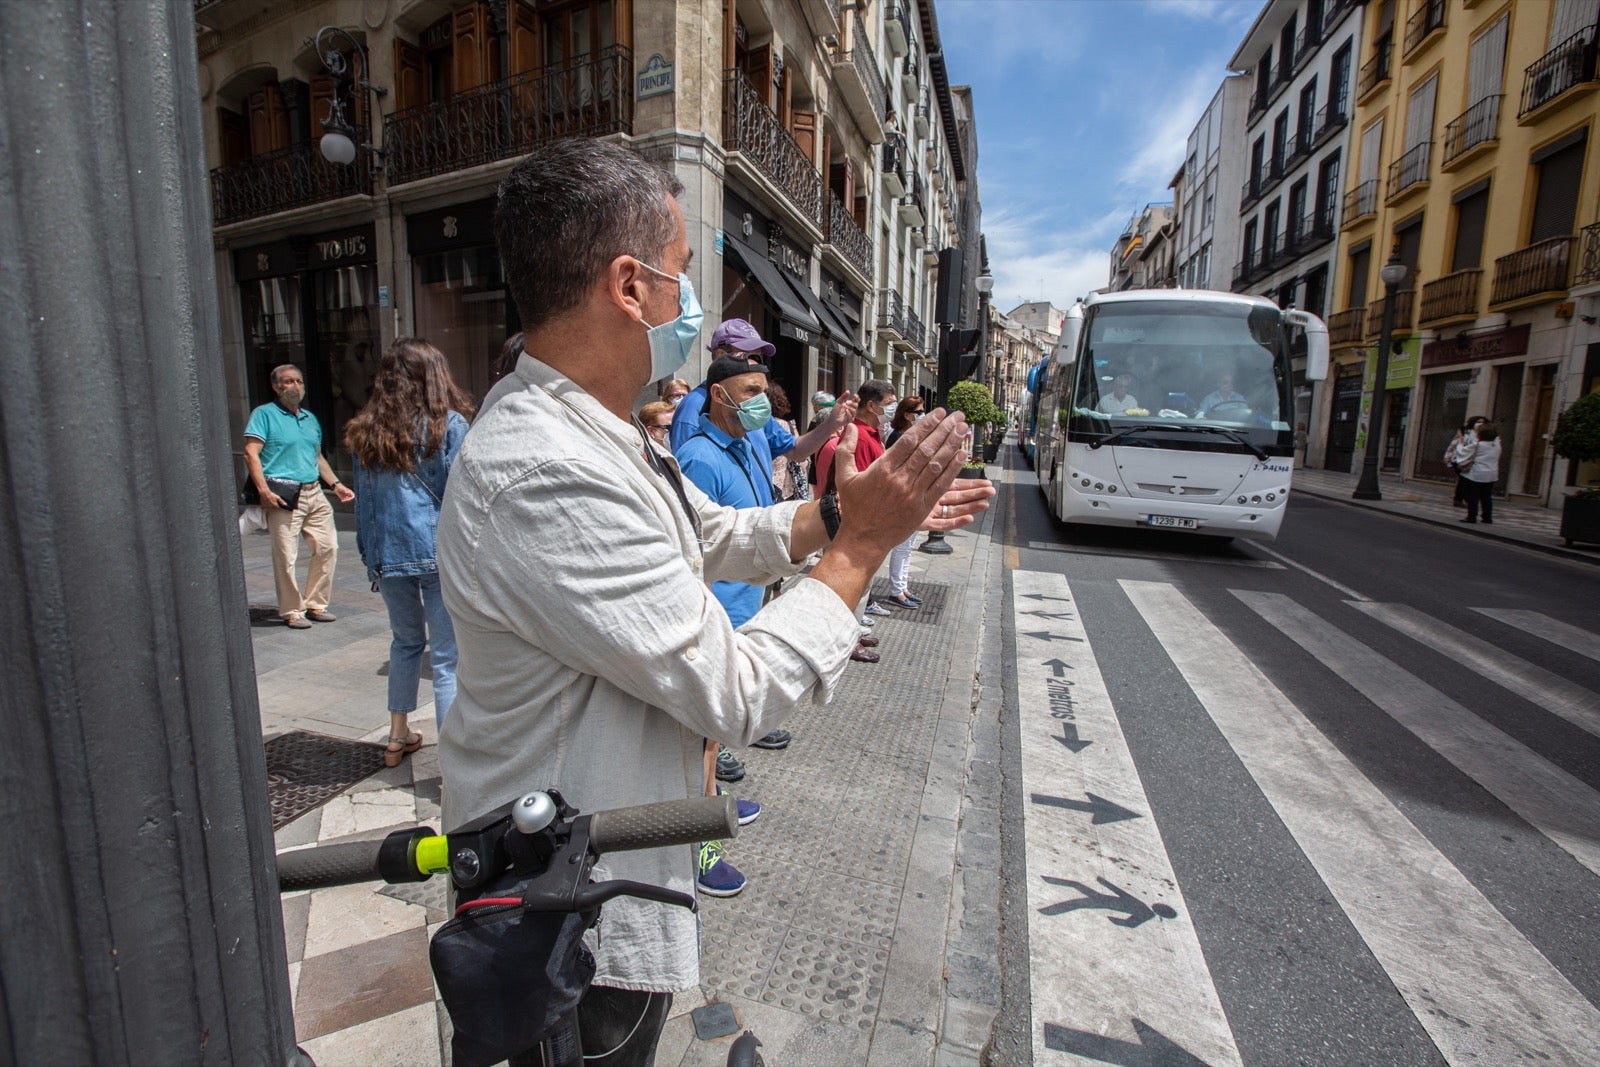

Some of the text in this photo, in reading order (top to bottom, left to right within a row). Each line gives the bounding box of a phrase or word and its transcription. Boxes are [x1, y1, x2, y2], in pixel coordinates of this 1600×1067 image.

[316, 235, 366, 260] TOUS
[1263, 464, 1289, 472] PALMA
[1155, 516, 1175, 526] 1239
